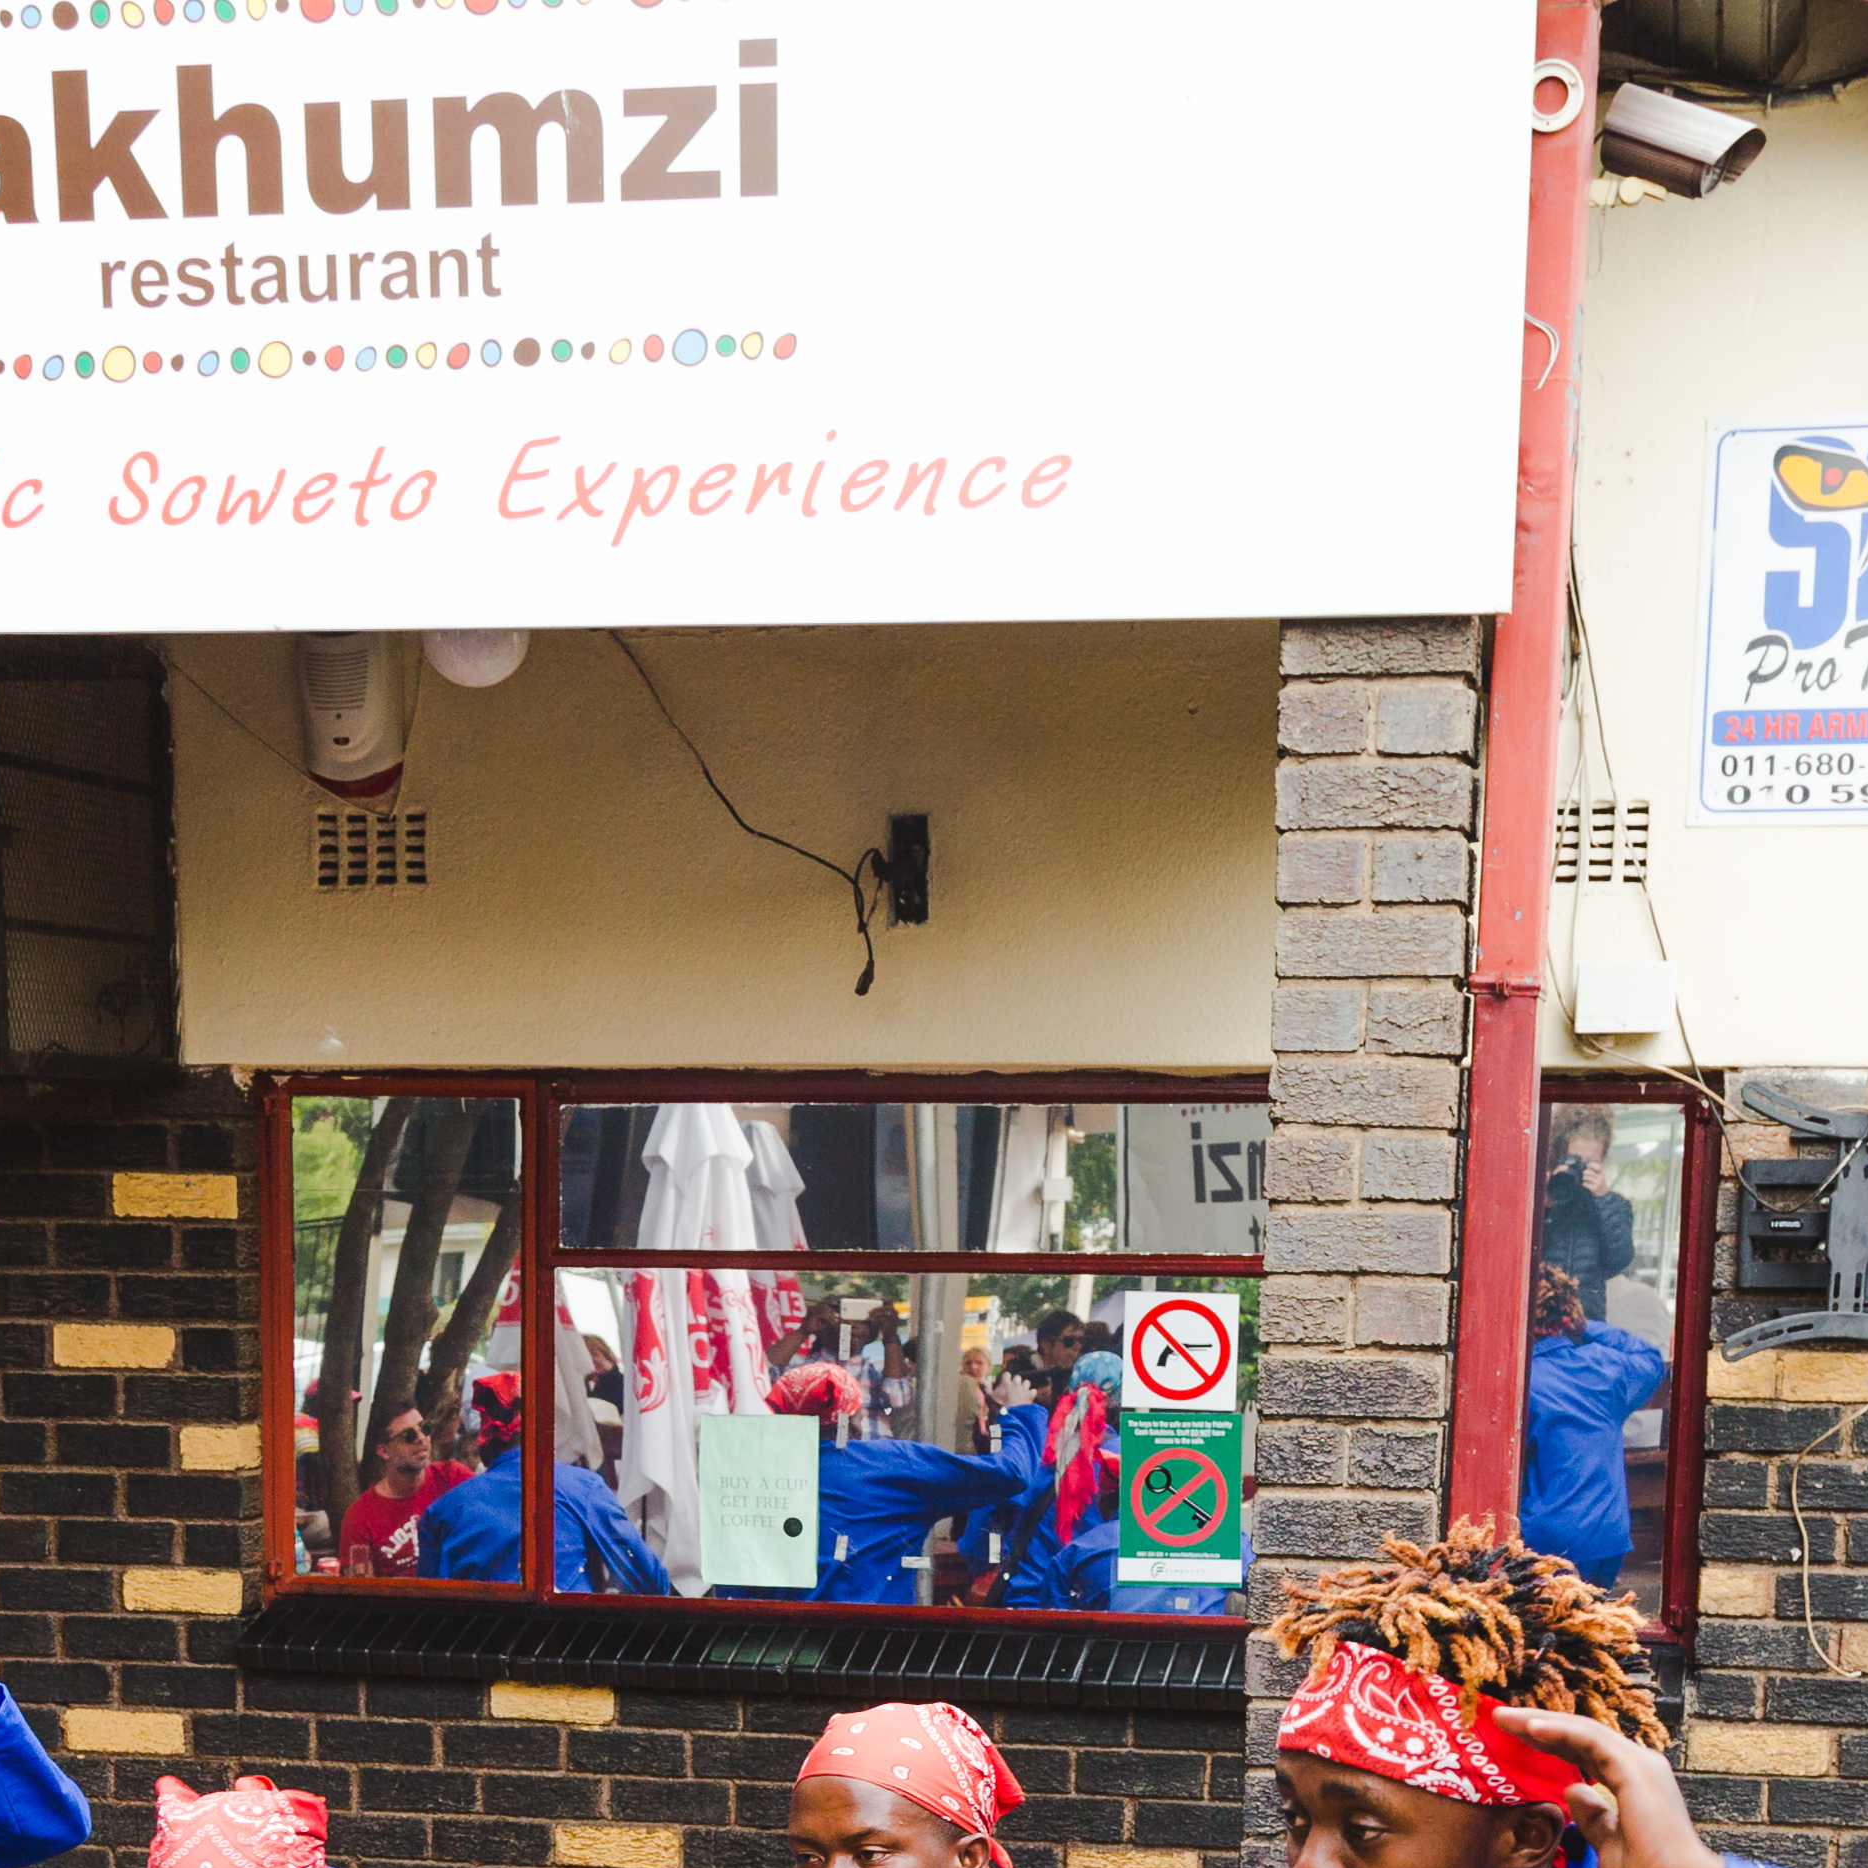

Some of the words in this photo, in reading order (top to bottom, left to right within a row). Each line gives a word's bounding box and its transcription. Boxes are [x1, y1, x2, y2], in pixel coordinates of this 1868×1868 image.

[98, 233, 503, 310] restaurant
[106, 448, 437, 529] Soweto
[496, 432, 1075, 547] Experience
[1724, 713, 1755, 742] 24
[1764, 712, 1800, 741] HR
[1726, 784, 1810, 805] 010
[720, 1476, 752, 1489] BUY
[759, 1477, 769, 1490] A
[775, 1478, 808, 1491] CUP
[720, 1495, 750, 1508] GET
[755, 1496, 790, 1509] FREE
[720, 1514, 776, 1528] COFFEE
